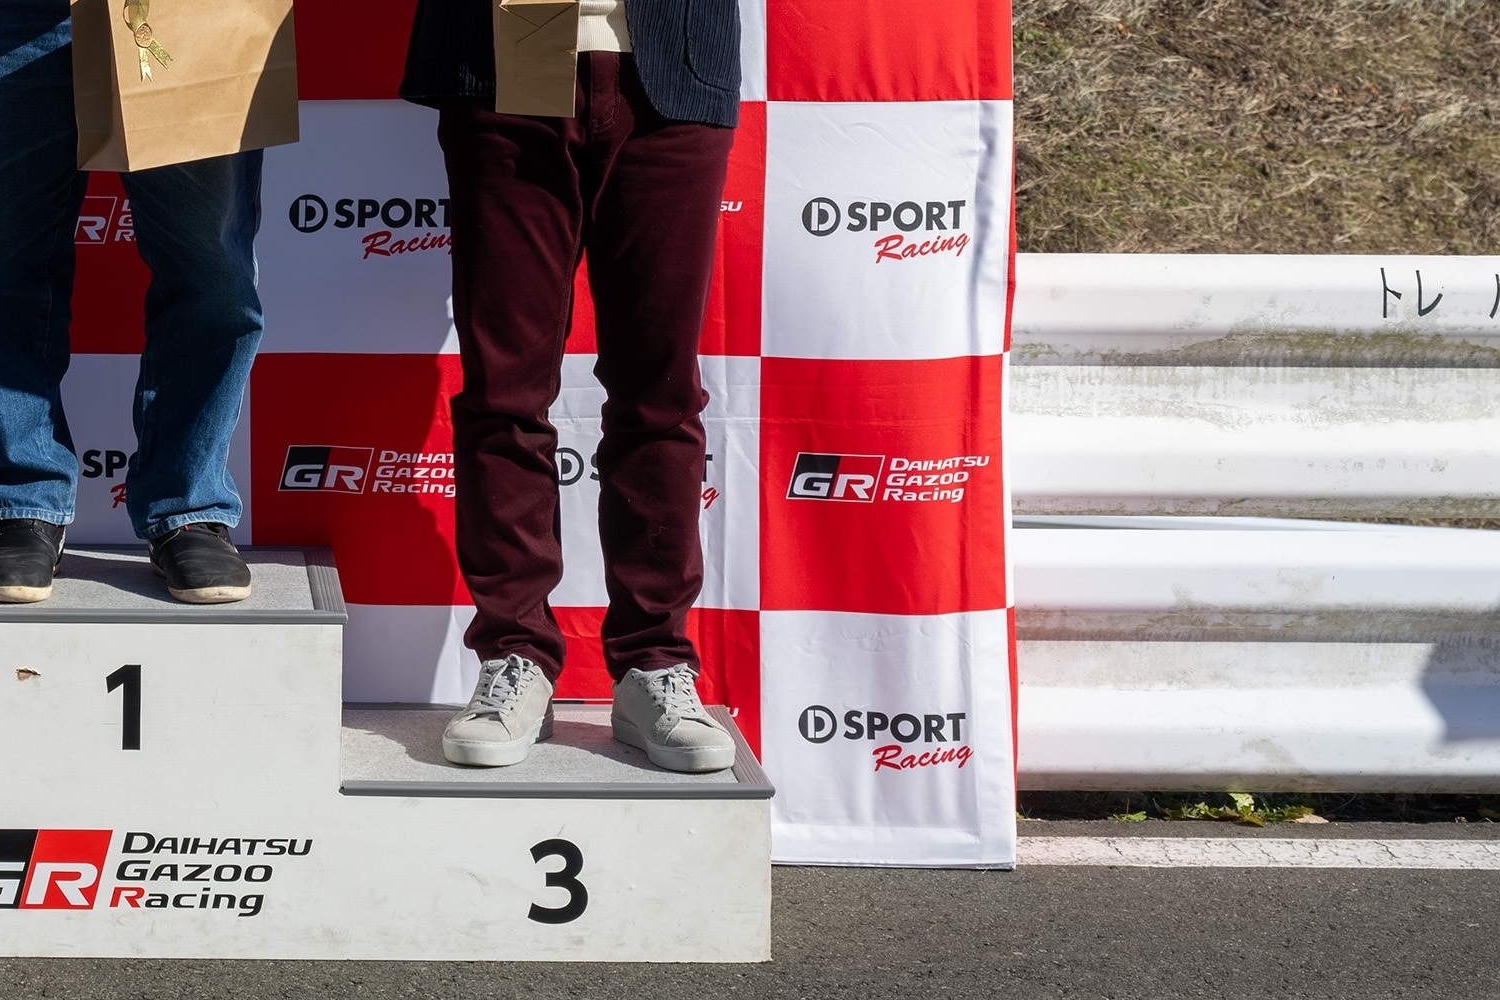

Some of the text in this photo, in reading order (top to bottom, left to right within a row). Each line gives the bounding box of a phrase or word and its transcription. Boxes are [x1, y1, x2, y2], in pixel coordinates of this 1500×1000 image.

[846, 200, 966, 233] SPORT
[874, 231, 970, 264] Racing
[378, 450, 454, 464] DAIHAT
[889, 456, 989, 471] DAIHATSU
[282, 465, 364, 491] GR
[794, 471, 874, 499] GR
[886, 472, 969, 486] GAZOO
[882, 487, 965, 503] Racing
[106, 664, 141, 750] 1
[843, 709, 965, 742] SPORT
[872, 744, 973, 772] Racing
[121, 832, 313, 857] DAIHATSU
[115, 860, 273, 883] GAZOO
[527, 838, 588, 925] 3
[109, 887, 265, 917] Racing
